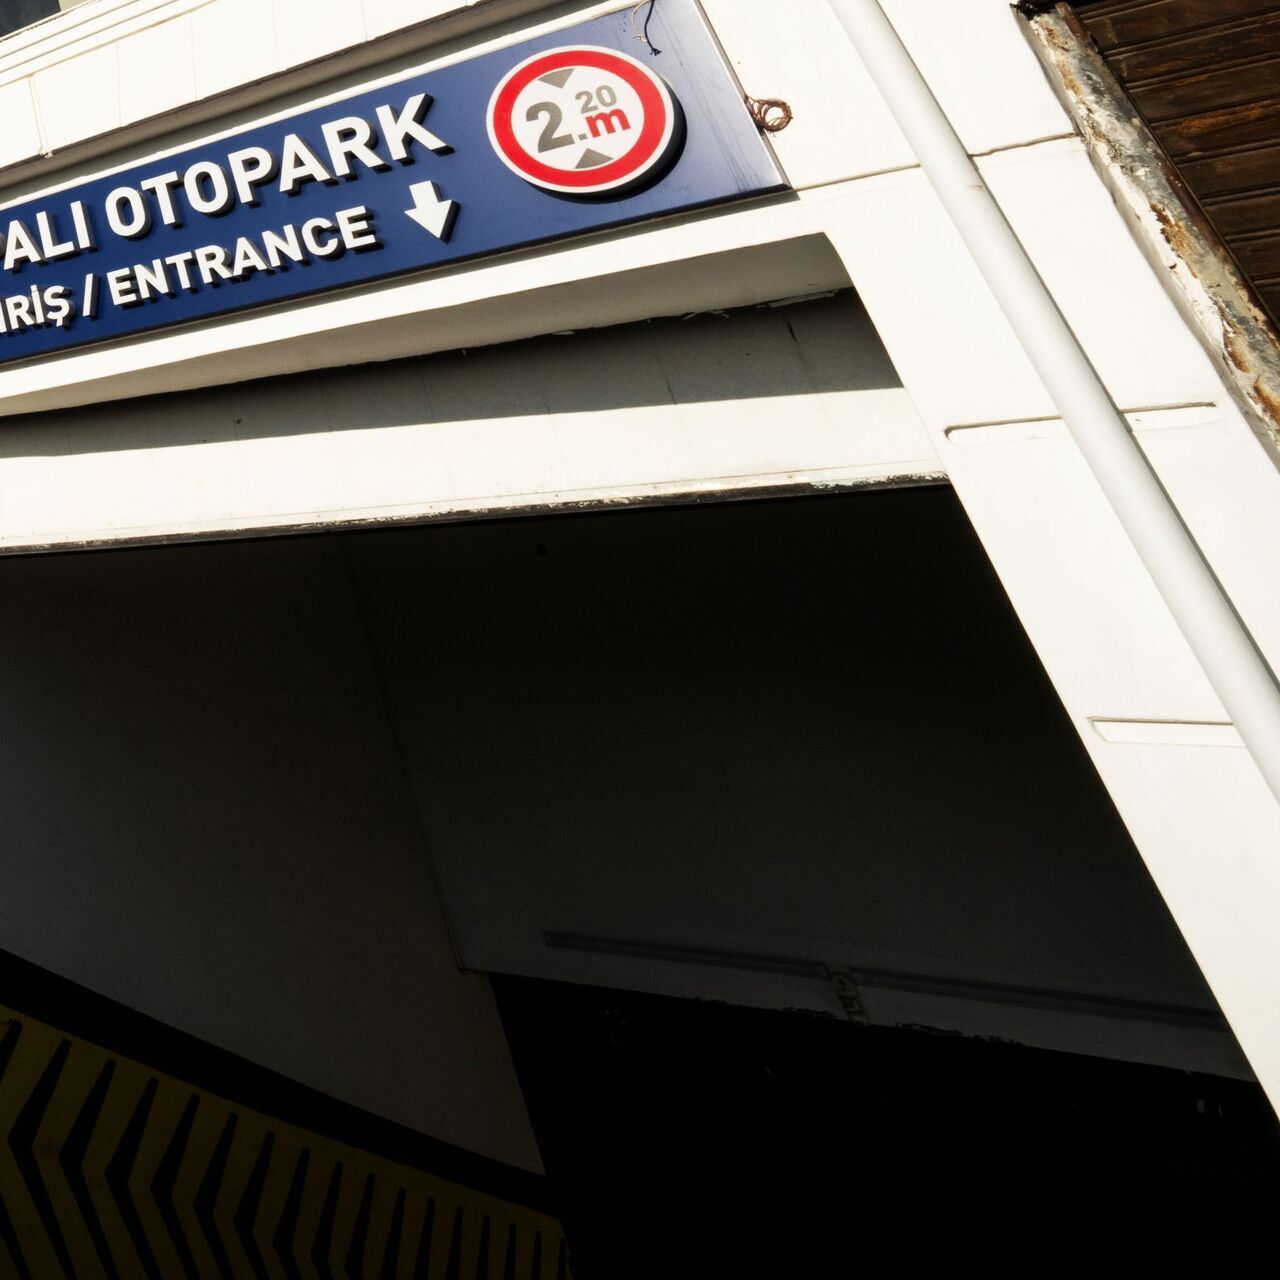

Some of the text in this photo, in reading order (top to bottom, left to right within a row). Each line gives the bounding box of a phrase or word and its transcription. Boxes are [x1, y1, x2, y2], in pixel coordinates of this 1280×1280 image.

[575, 85, 617, 114] 20
[105, 93, 448, 239] OTOPARK
[107, 206, 378, 306] ENTRANCE
